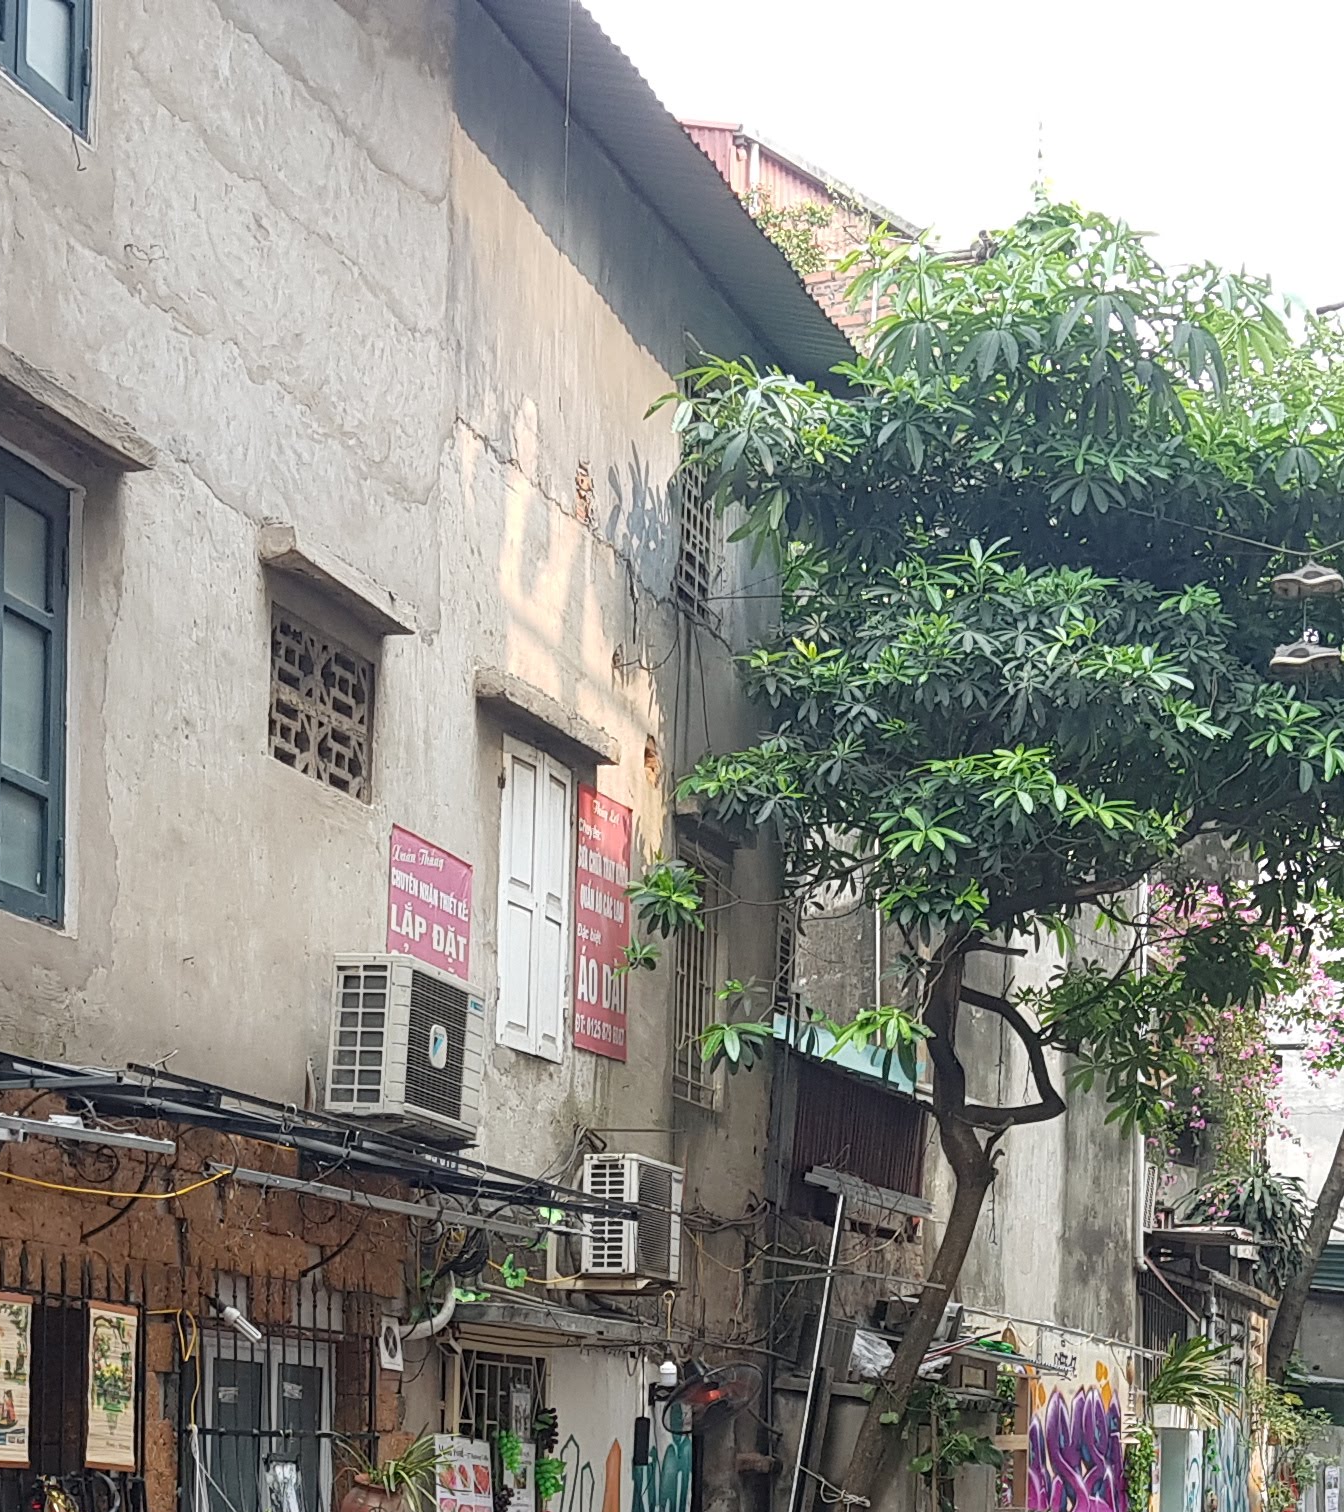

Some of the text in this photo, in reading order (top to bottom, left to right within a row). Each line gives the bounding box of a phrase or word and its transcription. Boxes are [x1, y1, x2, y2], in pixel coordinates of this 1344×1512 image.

[391, 901, 427, 942] LẮP
[432, 922, 467, 964] ĐẶT
[577, 945, 625, 1015] ÁO DÀI
